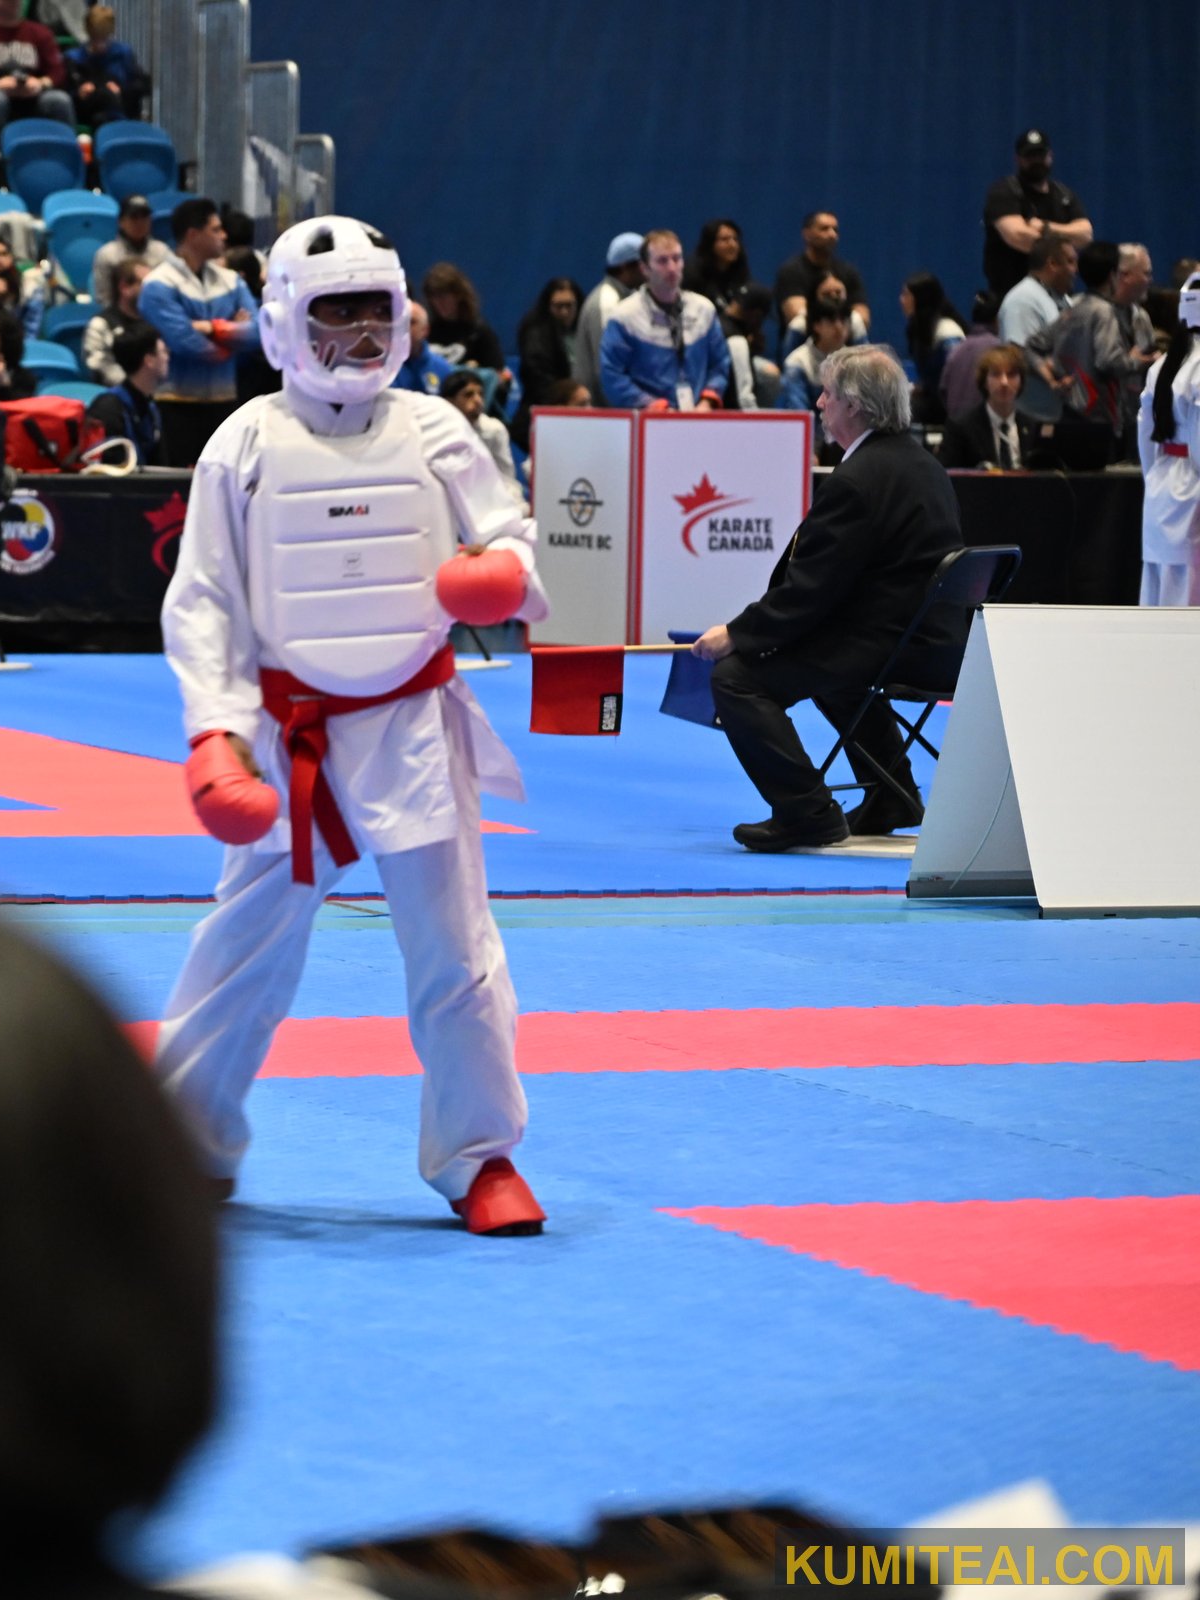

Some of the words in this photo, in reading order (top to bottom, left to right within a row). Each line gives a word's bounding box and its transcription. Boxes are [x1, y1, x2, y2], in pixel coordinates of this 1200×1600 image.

[708, 518, 773, 535] KARATE
[548, 532, 593, 549] KARATE
[596, 534, 612, 550] BC
[708, 535, 774, 551] CANADA
